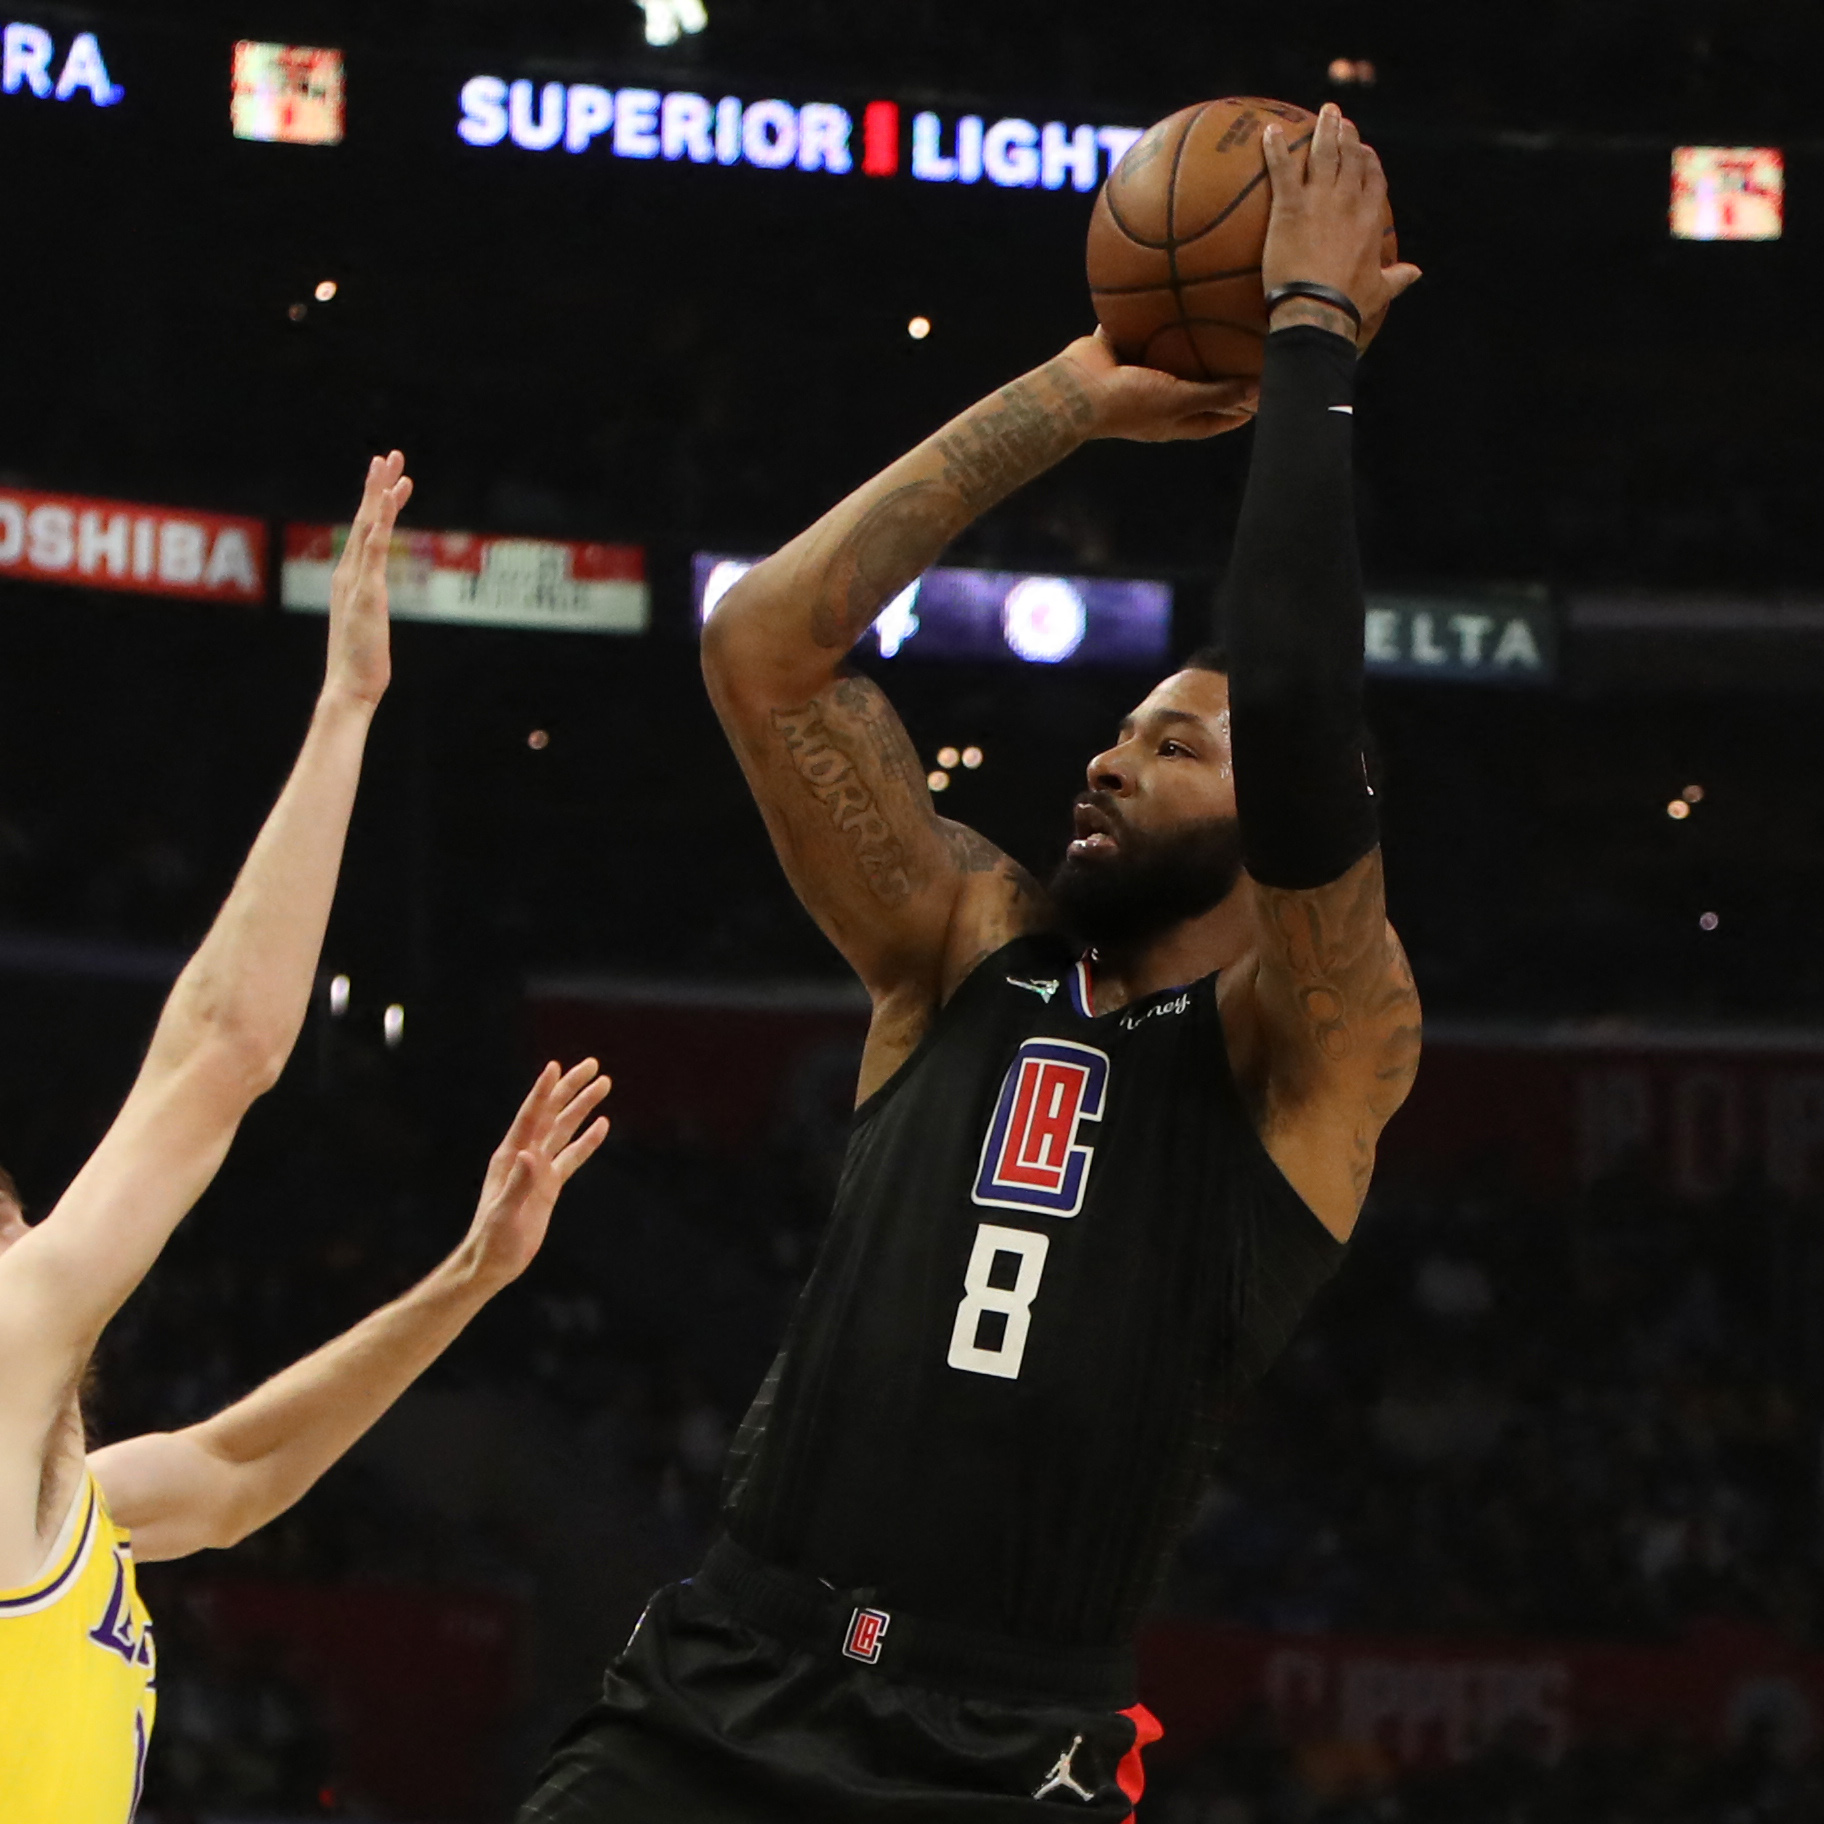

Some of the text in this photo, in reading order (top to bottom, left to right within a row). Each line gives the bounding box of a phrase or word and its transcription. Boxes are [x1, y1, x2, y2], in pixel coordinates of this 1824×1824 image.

[457, 75, 853, 175] SUPERIOR
[1364, 608, 1542, 670] ELTA
[947, 1223, 1050, 1380] 8
